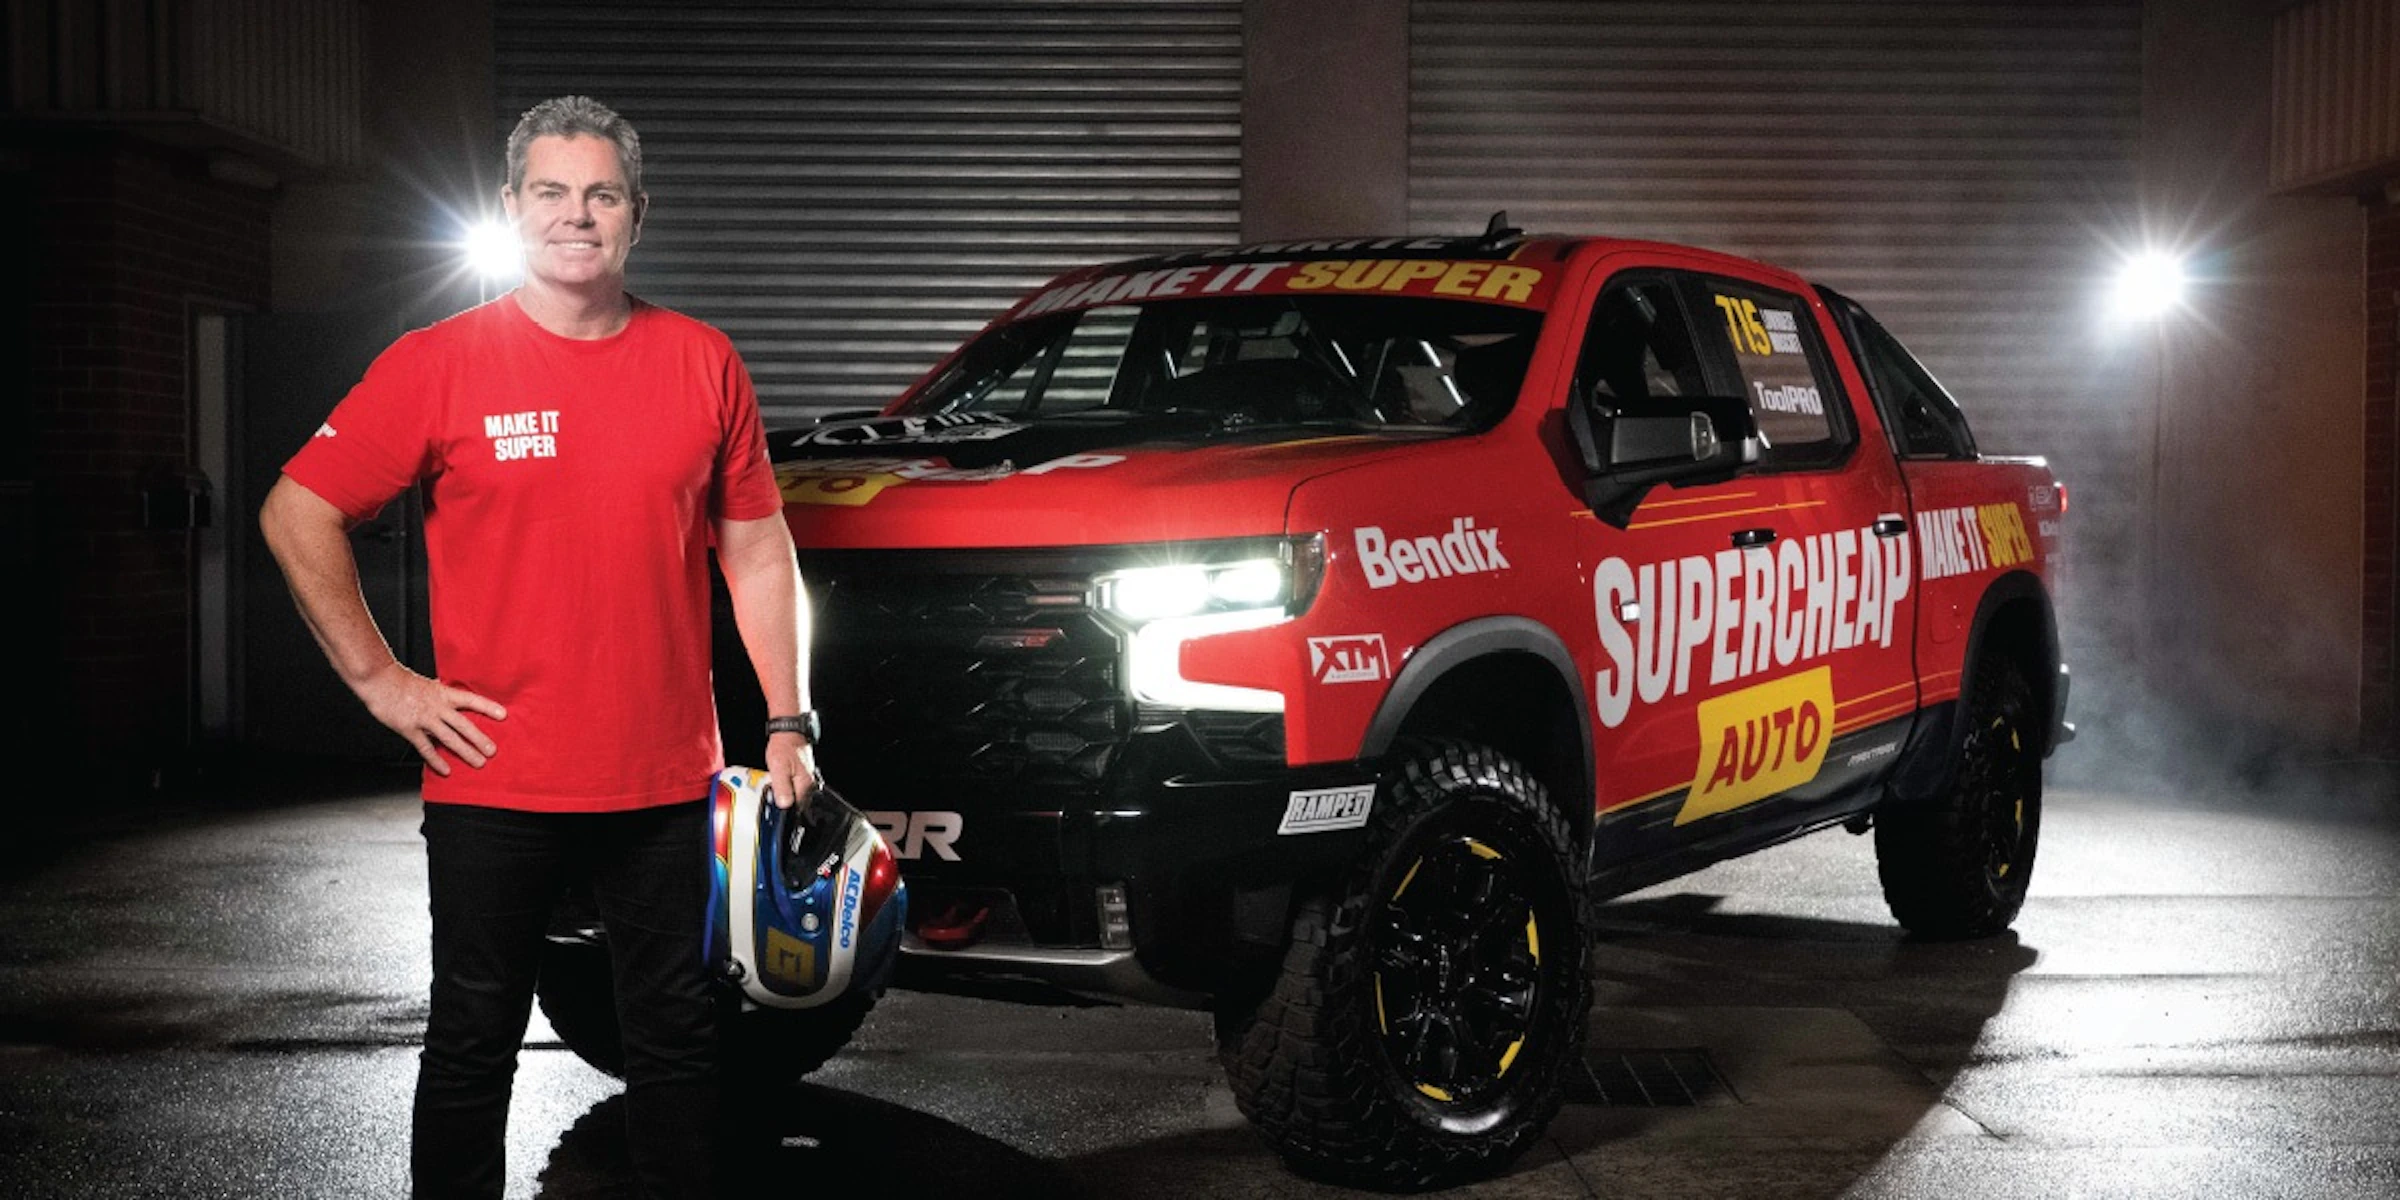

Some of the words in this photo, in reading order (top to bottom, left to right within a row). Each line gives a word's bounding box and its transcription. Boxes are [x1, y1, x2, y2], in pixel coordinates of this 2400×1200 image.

[1013, 265, 1210, 320] MAKE
[1201, 260, 1290, 294] IT
[1287, 259, 1544, 303] SUPER
[1714, 294, 1772, 356] 715
[484, 412, 539, 438] MAKE
[541, 411, 560, 433] IT
[1753, 381, 1824, 415] ToolPRO
[494, 435, 557, 461] SUPER
[1353, 516, 1511, 590] Bendix
[1916, 507, 1971, 581] MAKE
[1961, 505, 1988, 572] IT
[1978, 502, 2035, 568] SUPER
[1593, 512, 1911, 728] SUPERCHEAP
[1310, 637, 1388, 683] XTM
[1703, 700, 1821, 795] AUTO
[839, 868, 861, 949] ACDelco
